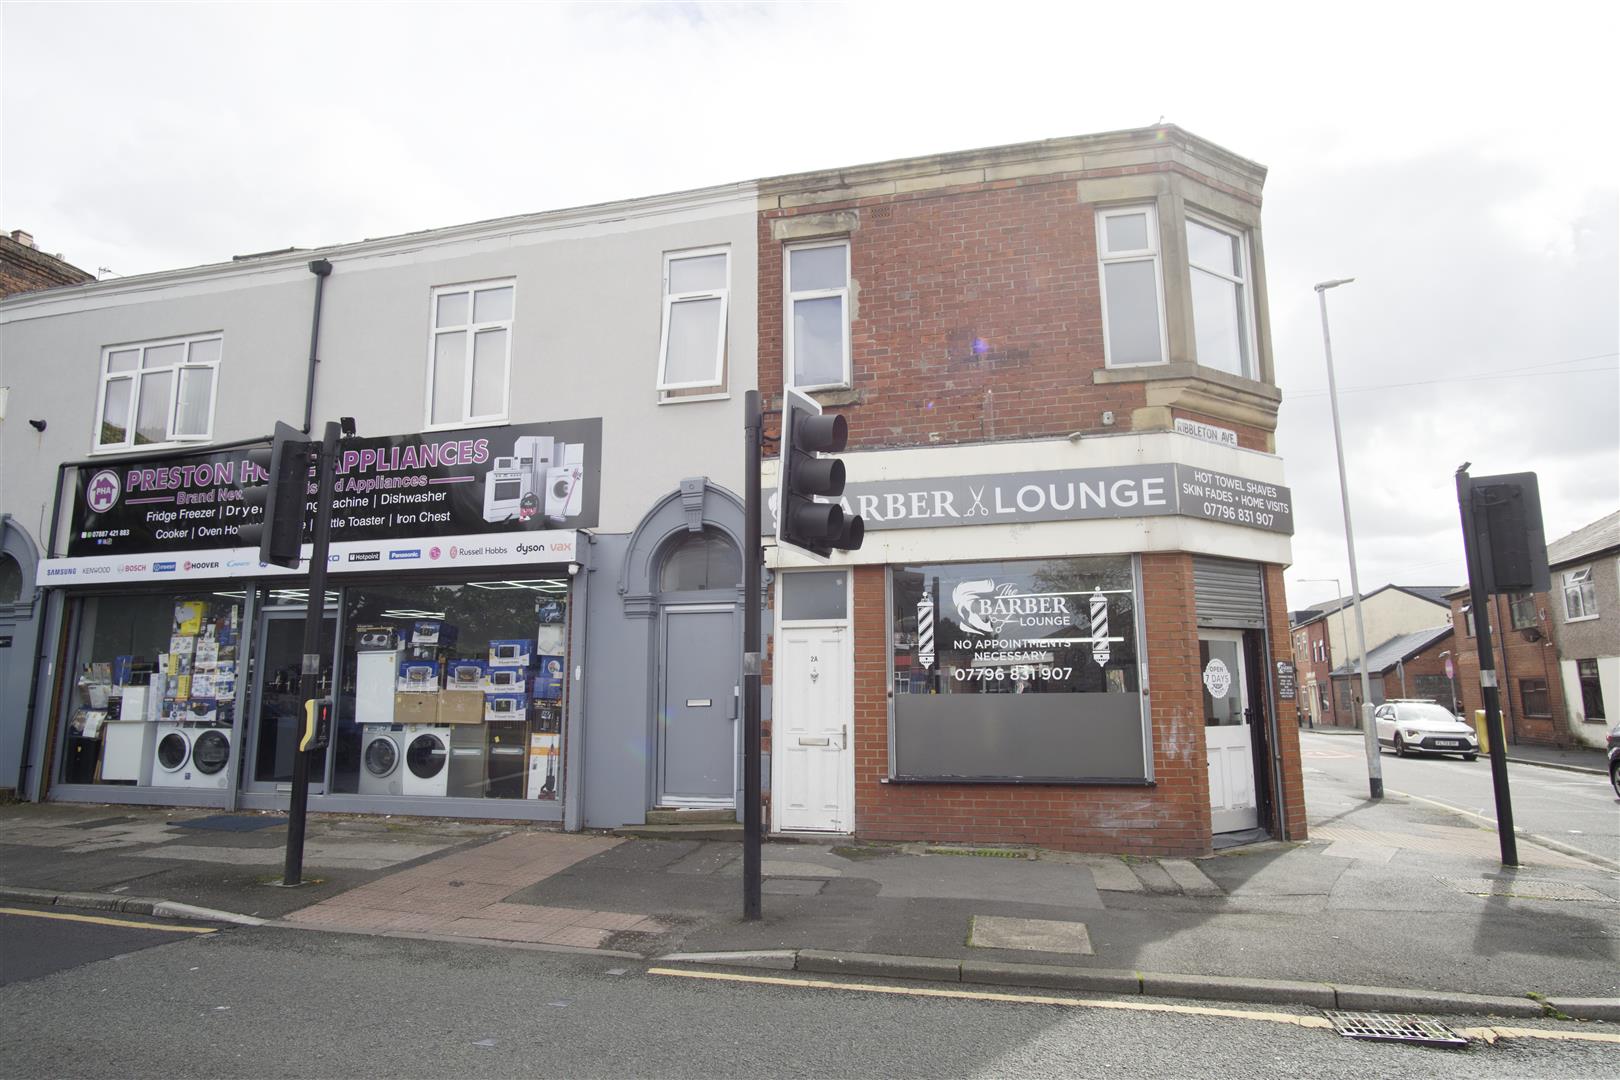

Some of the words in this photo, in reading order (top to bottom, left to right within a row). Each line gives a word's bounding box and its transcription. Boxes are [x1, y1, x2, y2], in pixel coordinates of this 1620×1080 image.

[1177, 420, 1217, 440] RIBBLETON
[126, 461, 234, 492] PRESTON
[96, 486, 112, 495] PHA
[346, 475, 428, 494] Appliances
[1194, 471, 1213, 484] HOT
[1215, 474, 1245, 491] TOWEL
[1246, 482, 1277, 497] SHAVES
[177, 489, 215, 505] Brand
[332, 496, 369, 509] achine
[381, 490, 447, 505] Dishwasher
[813, 490, 960, 522] ARBER
[994, 477, 1167, 514] LOUNGE
[1183, 483, 1204, 497] SKIN
[1205, 488, 1233, 503] FADES
[1241, 495, 1264, 509] HOME
[1265, 499, 1289, 513] VISITS
[146, 510, 177, 523] Fridge
[179, 508, 216, 519] Freezer
[330, 518, 345, 528] ttle
[349, 515, 385, 527] Toaster
[397, 513, 416, 524] Iron
[419, 511, 451, 523] Chest
[1203, 502, 1236, 520] 07796
[1238, 509, 1254, 524] 831
[1256, 512, 1274, 526] 907
[156, 528, 188, 540] Cooker
[198, 526, 222, 537] Oven
[224, 525, 241, 535] Ho
[460, 547, 483, 556] Russell
[485, 546, 508, 554] Hobbs
[516, 543, 545, 555] dyson
[550, 542, 572, 552] vax
[355, 552, 380, 561] Hotpoint
[391, 551, 419, 559] Panasonic
[47, 567, 77, 576] SAMSUNG
[82, 566, 111, 574] KENWOOD
[125, 564, 146, 572] BOSCH
[191, 561, 219, 569] HOOVER
[995, 582, 1018, 597] The
[978, 597, 1070, 615] BARBER
[1020, 616, 1071, 626] LOUNGE
[953, 640, 972, 649] NO
[975, 639, 1071, 649] APPOINTMENTS
[974, 651, 1047, 661] NECESSARY
[955, 668, 1005, 680] 07796
[1010, 667, 1036, 680] 831
[1041, 667, 1073, 680] 907
[1205, 674, 1210, 682] 7
[1211, 674, 1229, 682] DAYS
